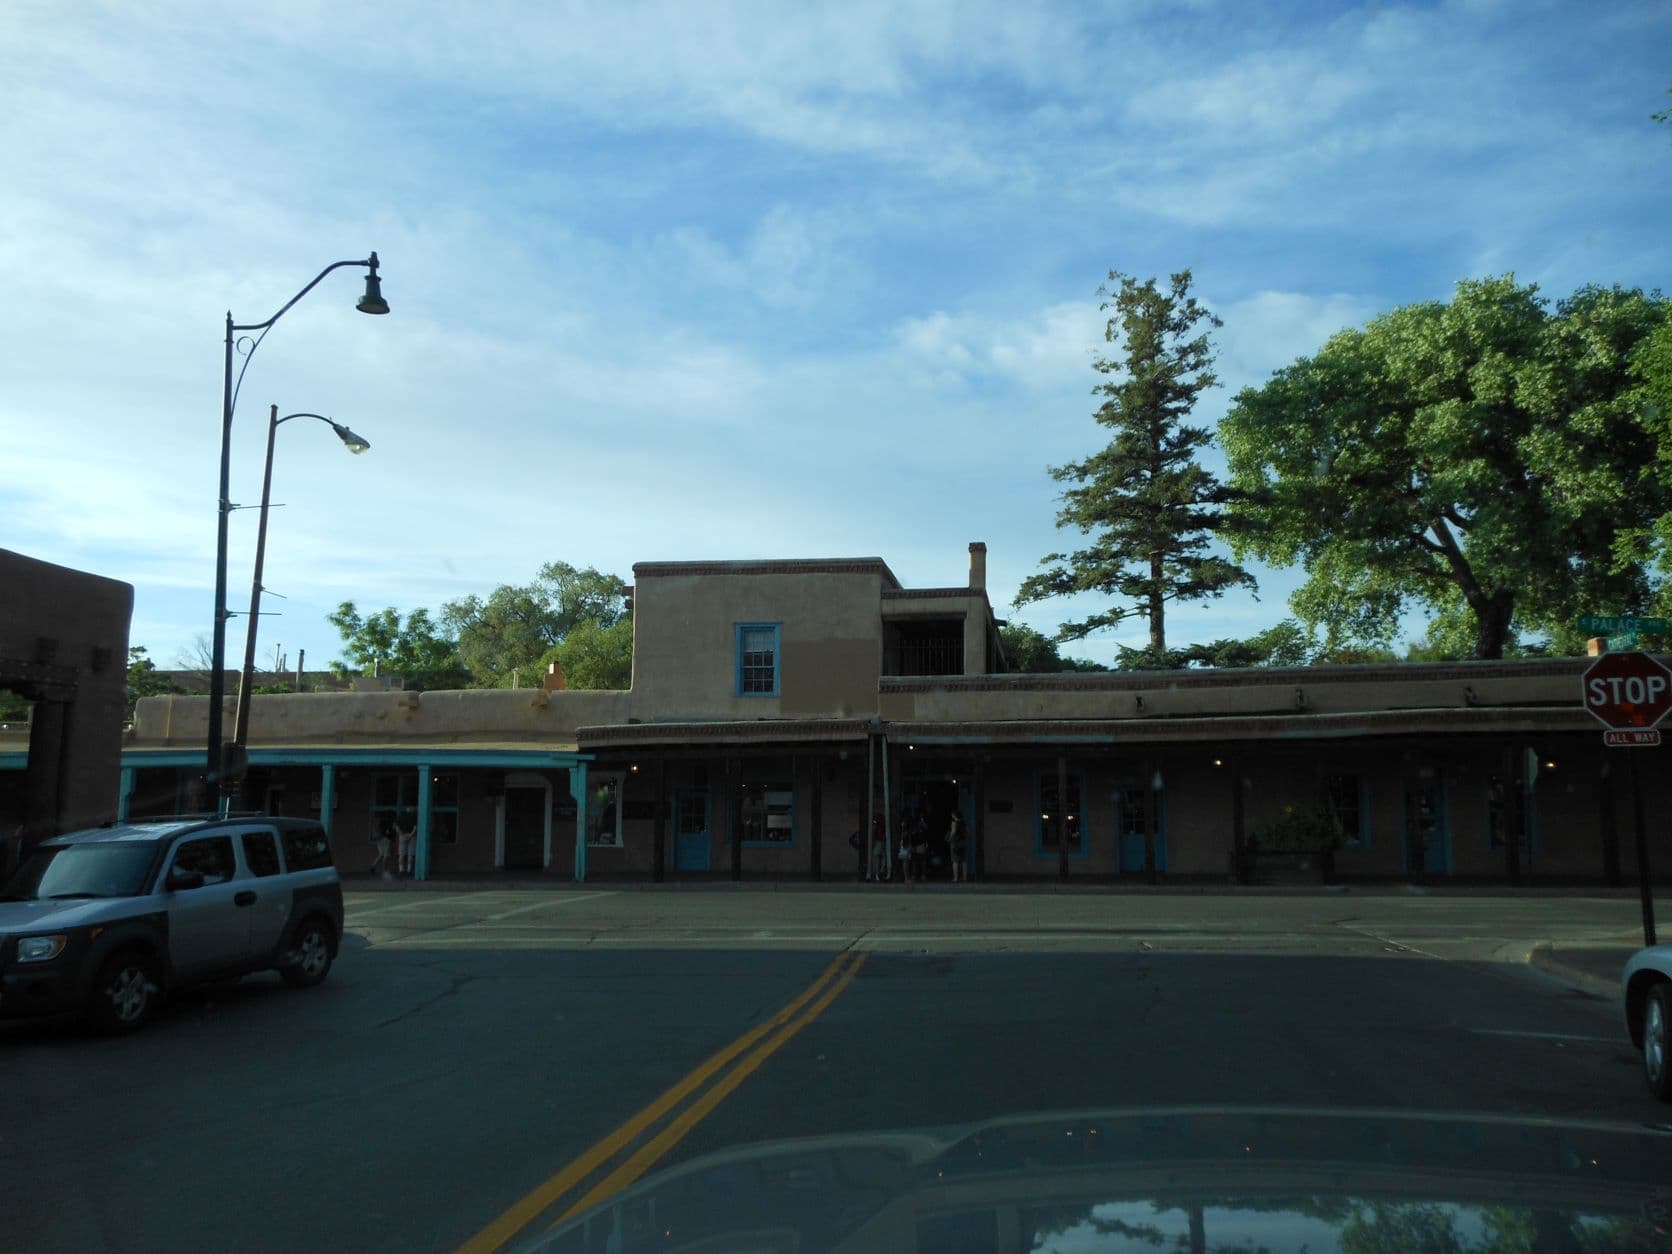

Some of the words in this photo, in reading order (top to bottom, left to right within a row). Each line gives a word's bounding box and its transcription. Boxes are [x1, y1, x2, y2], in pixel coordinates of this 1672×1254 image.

[1591, 618, 1643, 631] PALACE
[1589, 675, 1666, 706] STOP
[1609, 733, 1630, 743] ALL
[1634, 732, 1655, 743] WAY
